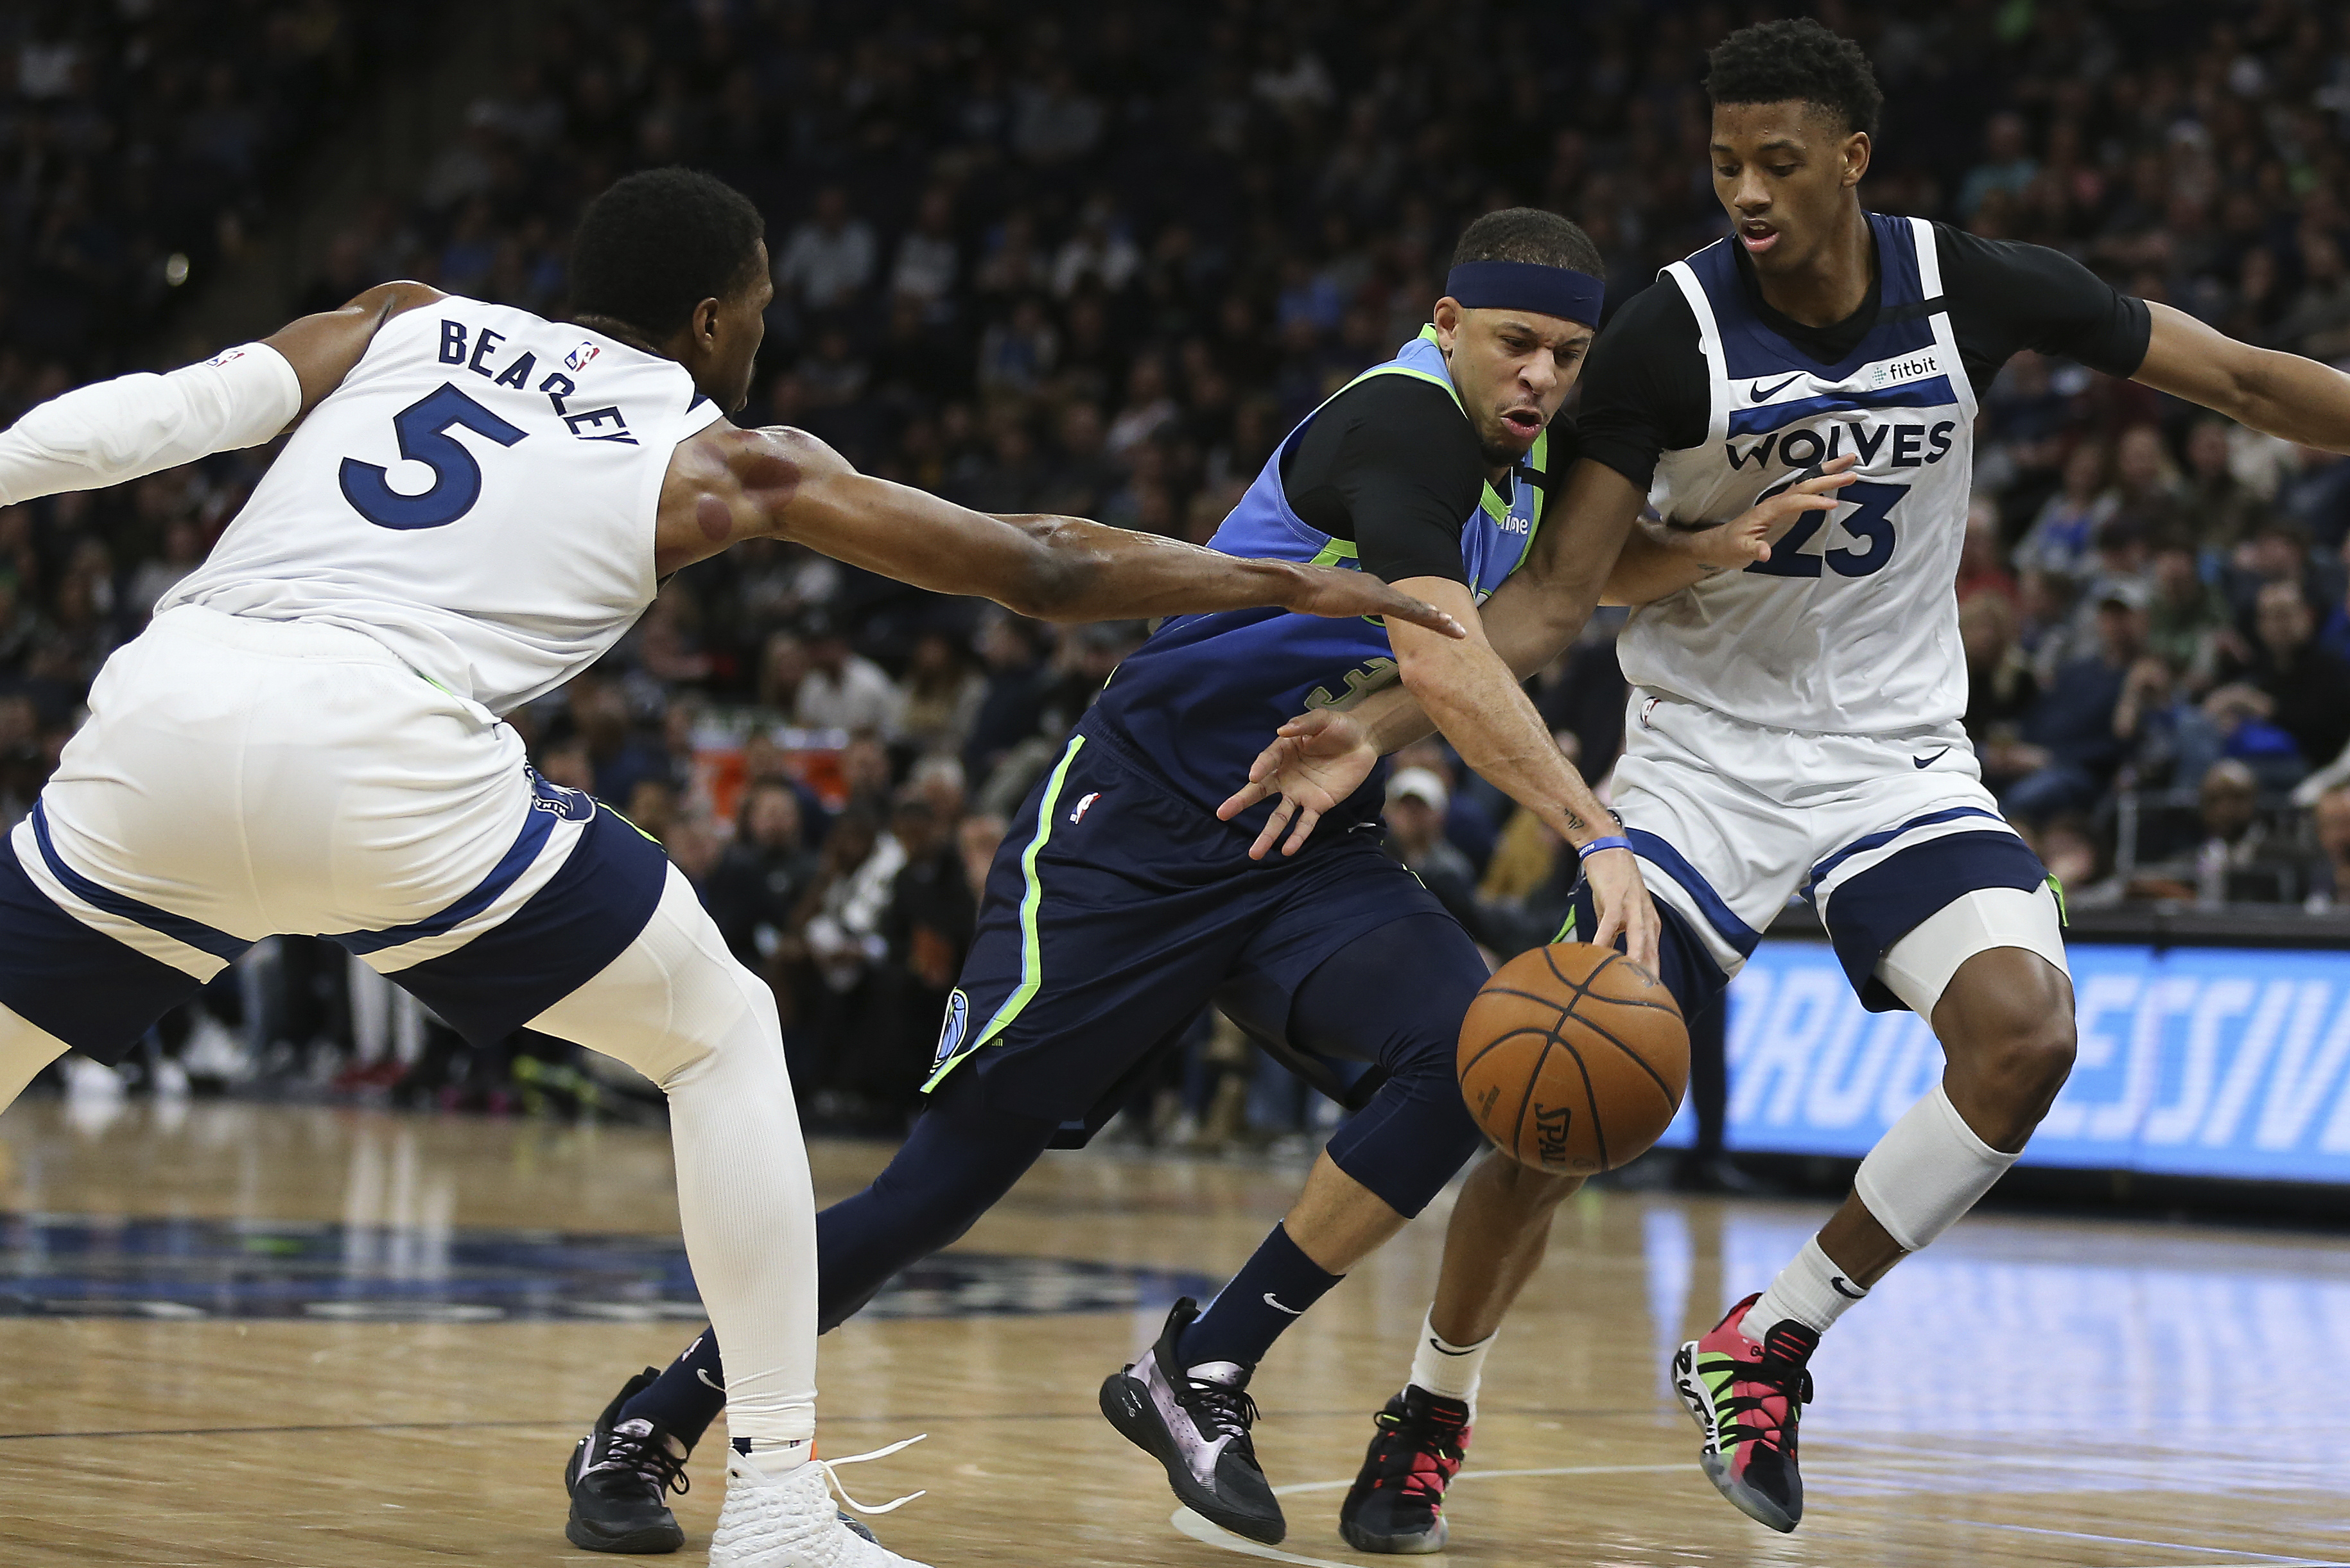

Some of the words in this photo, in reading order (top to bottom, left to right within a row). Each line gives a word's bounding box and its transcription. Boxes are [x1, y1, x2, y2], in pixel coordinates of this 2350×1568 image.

[1890, 356, 1937, 381] fitbit
[338, 381, 530, 530] 5
[1743, 481, 1911, 578] 23
